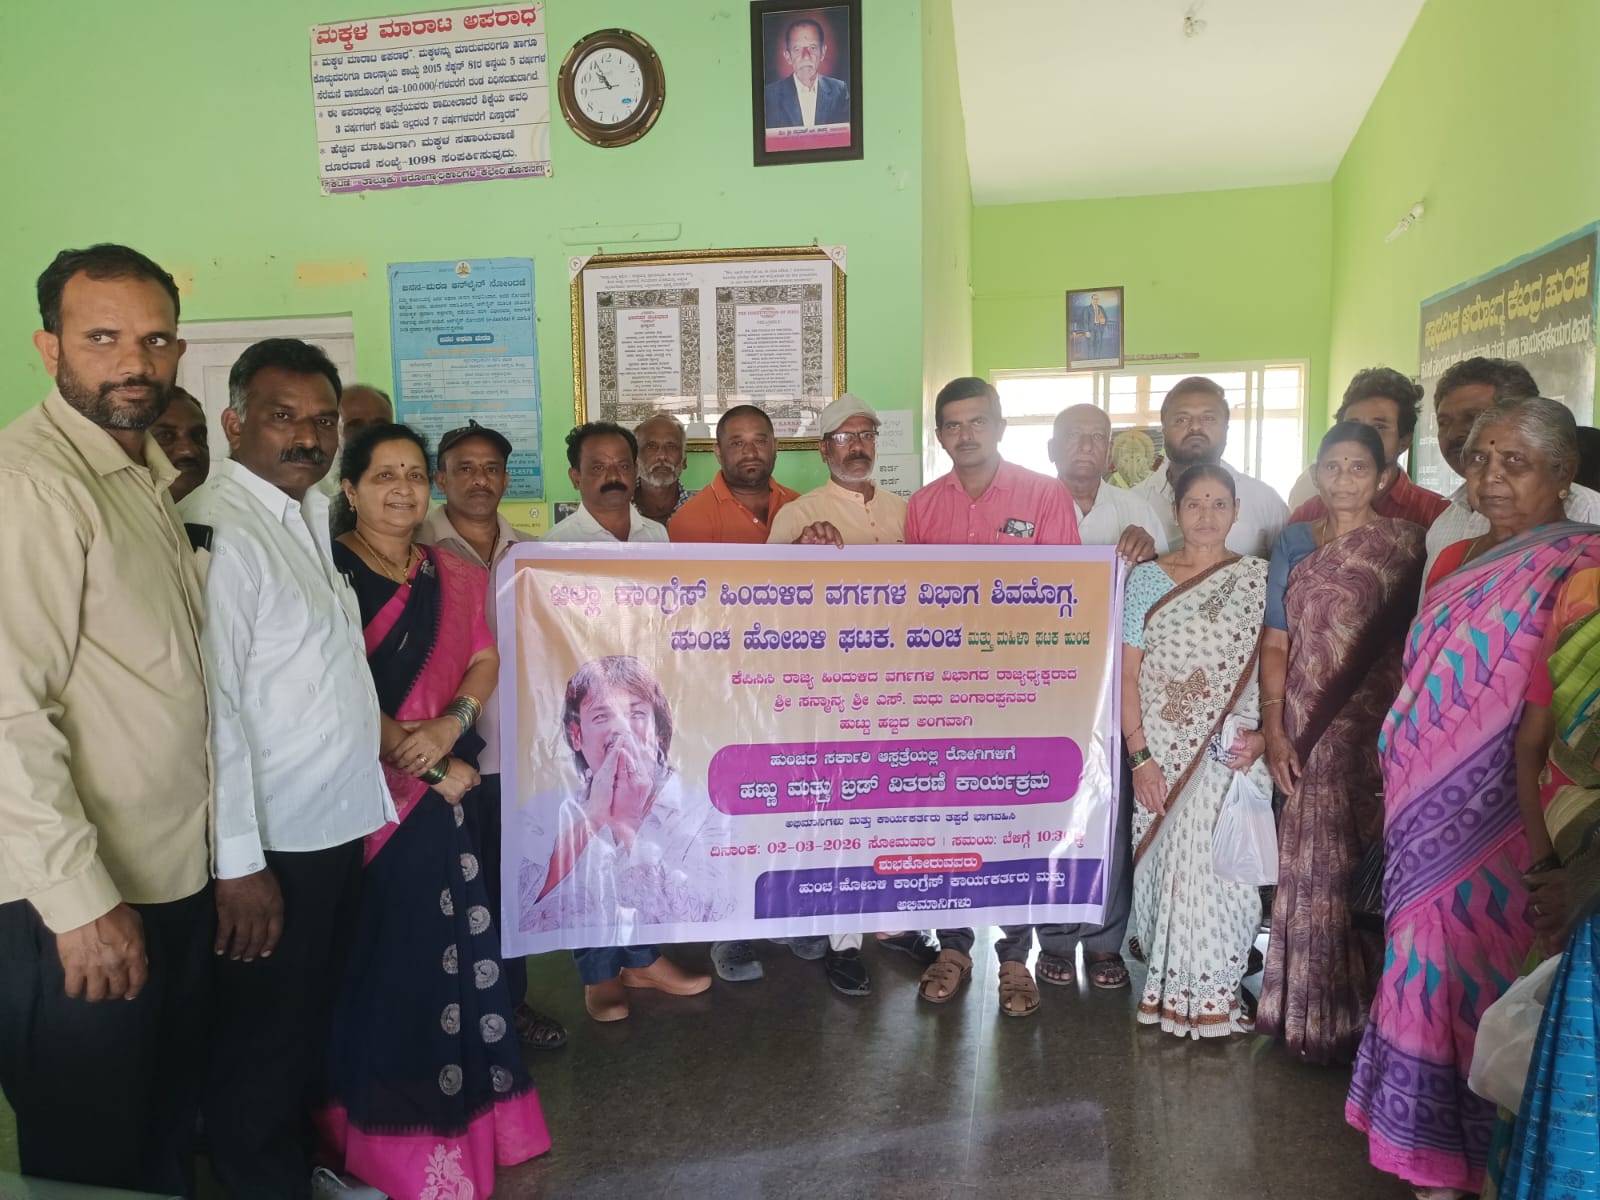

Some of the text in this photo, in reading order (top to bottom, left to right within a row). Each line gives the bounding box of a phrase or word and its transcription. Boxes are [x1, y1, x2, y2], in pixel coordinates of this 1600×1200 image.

[316, 6, 537, 51] ಮಕ್ಕಳ ಮಾರಾಟ ಅಪರಾಧ
[422, 64, 442, 74] 2015
[335, 125, 341, 134] 3
[433, 117, 438, 125] 7
[550, 576, 1079, 618] ಜಿಲ್ಲಾ ಕಾಂಗ್ರೆಸ್ ಹಿಂದುಳಿದ ವರ್ಗಗಳ ವಿಭಾಗ ಶಿವಮೊಗ್ಗ.
[671, 622, 1091, 653] ಹುಂಚ ಹೋಬಳಿ ಘಟಕ. ಹುಂಚ ಮತ್ತು ಮಹಿಳಾ ಘಟಕ ಹುಂಚ
[731, 670, 775, 685] ಕೆಪಿಸಿಸಿ
[782, 672, 815, 690] ರಾಜ್ಯ
[822, 671, 879, 684] ಹಿಂದುಳಿದ
[885, 670, 935, 683] ವರ್ಗಗಳ
[942, 669, 989, 683] ವಿಭಾಗದ
[773, 693, 792, 712] ಶ್ರೀ
[799, 695, 846, 713] ಸನ್ಮಾನ್ಯ
[851, 692, 869, 710] ಶ್ರೀ
[912, 694, 943, 707] ಮಧು
[950, 691, 1037, 708] ಬಂಗಾರಪ್ಪನವರ
[839, 715, 973, 735] ಹುಟ್ಟು ಹಬ್ಬದ ಅಂಗವಾಗಿ
[770, 751, 818, 766] ಹುಂಚದ
[824, 751, 871, 765] ಸರ್ಕಾರಿ
[945, 745, 1017, 761] ರೋಗಿಗಳಿಗೆ
[739, 779, 778, 807] ಹಣ್ಣು
[787, 778, 832, 803] ಮತ್ತು
[888, 771, 946, 793] ವಿತರಣೆ
[955, 770, 1050, 796] ಕಾರ್ಯಕ್ರಮ
[785, 811, 1017, 829] ಅಭಿಮಾನಿಗಳು ಮತ್ತು ಕಾರ್ಯಕರ್ತರು ತಪ್ಪದೆ ಭಾಗವಹಿಸಿ
[710, 843, 761, 857] ದಿನಾಂಕ:
[767, 838, 861, 854] 02-03-2026
[868, 835, 936, 849] ಸೋಮವಾರ
[952, 834, 997, 848] ಸಮಯ:
[878, 855, 977, 871] ಶುಭಕೋರುವವರು
[799, 871, 1066, 894] ಹುಂಚ ಹೋಬಳಿ ಕಾಂಗ್ರೆಸ್ ಕಾರ್ಯಕರ್ತರು ಮತ್ತು
[897, 897, 972, 912] ಅಭಿಮಾನಿಗಳು
